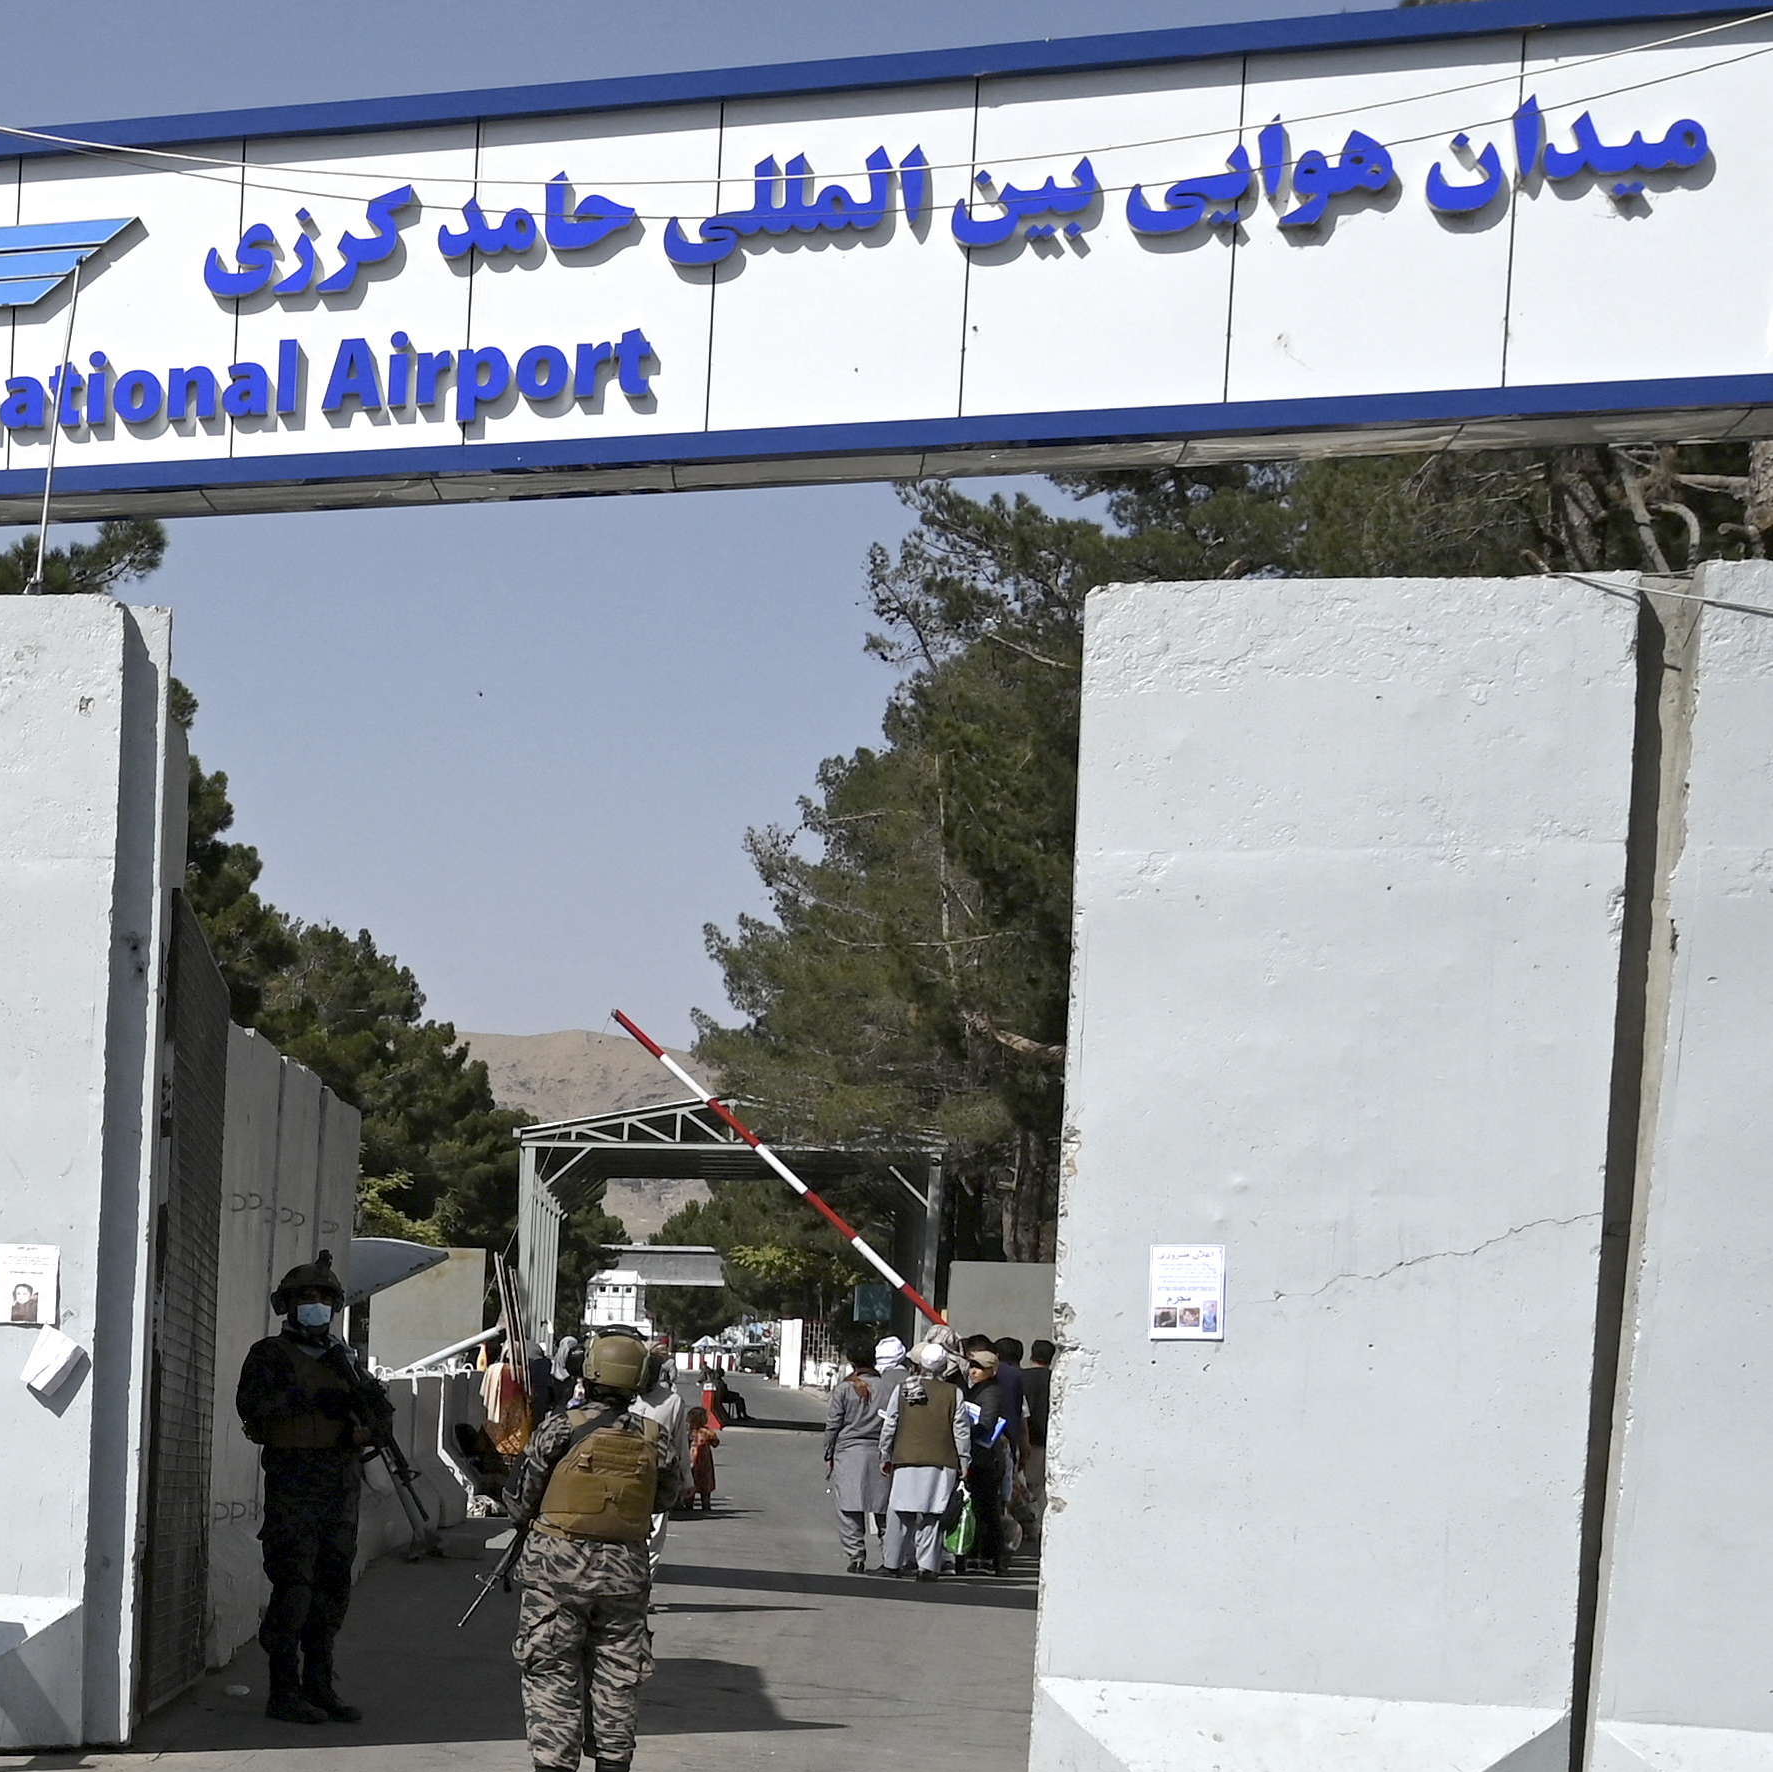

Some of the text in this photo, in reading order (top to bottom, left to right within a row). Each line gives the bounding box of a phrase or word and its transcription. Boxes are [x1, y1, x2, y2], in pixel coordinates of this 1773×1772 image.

[203, 95, 1710, 297] میدان هوایی بین المللی حامد کرزی
[322, 328, 653, 424] Airport
